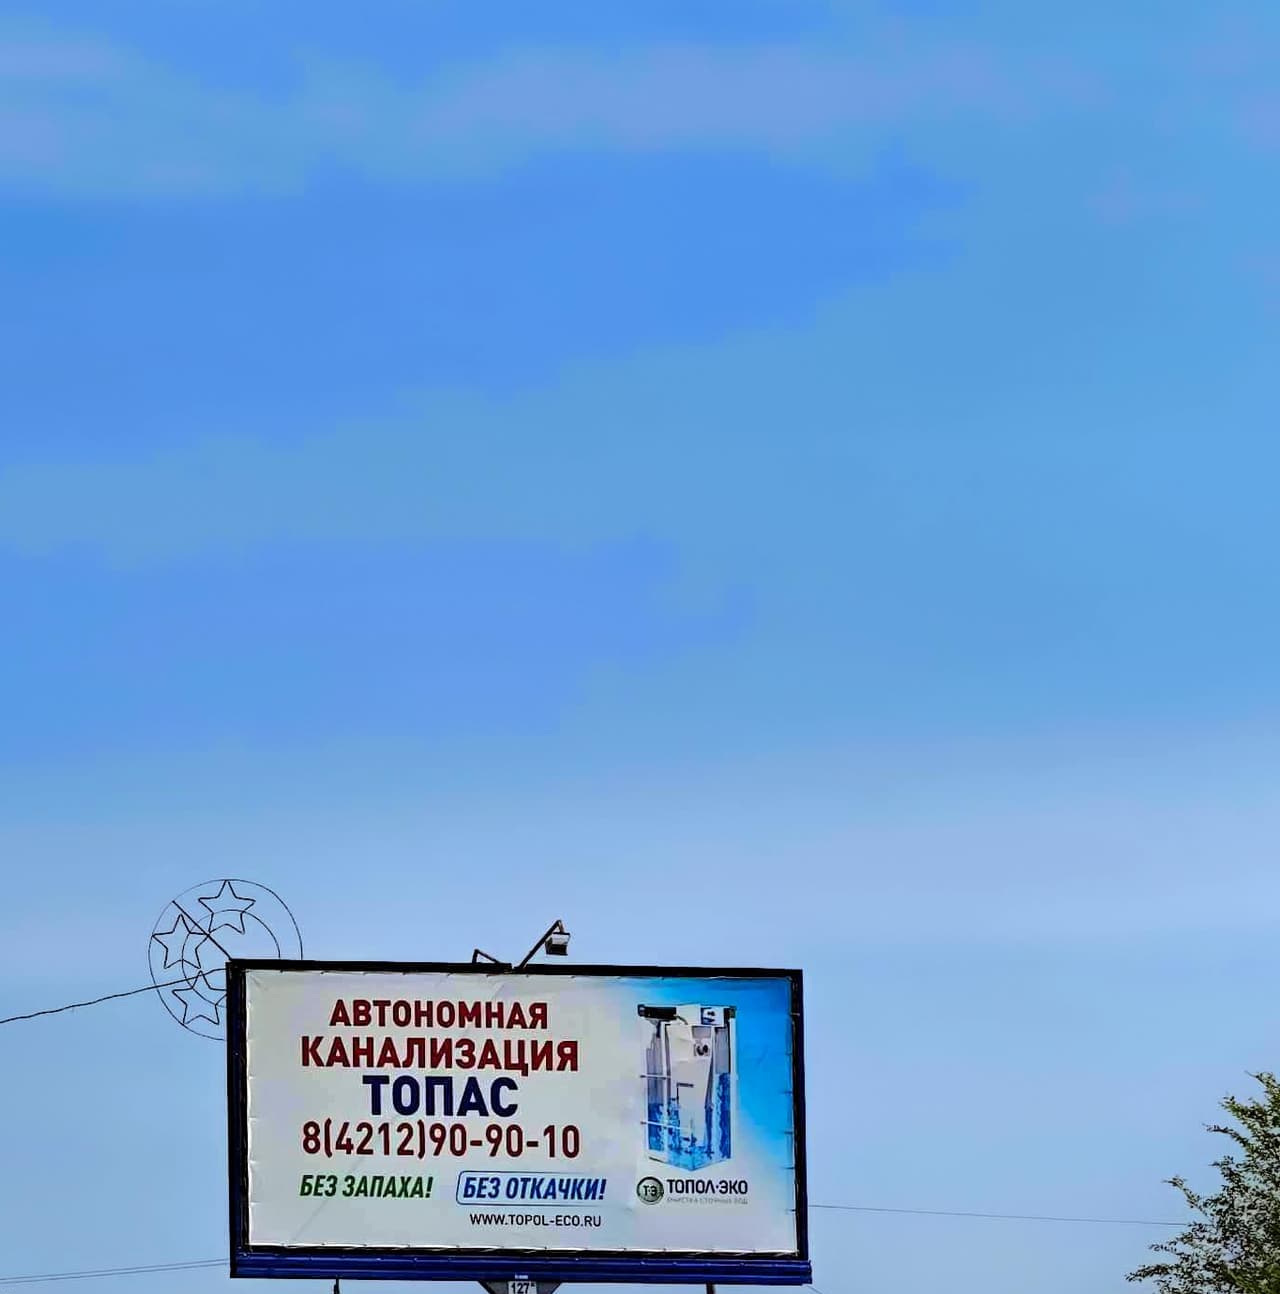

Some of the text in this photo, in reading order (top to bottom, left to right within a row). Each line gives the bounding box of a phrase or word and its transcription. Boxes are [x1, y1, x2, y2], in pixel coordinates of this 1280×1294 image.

[329, 999, 548, 1029] АВТОНОМНАЯ
[301, 1036, 579, 1077] КАНАЛИЗАЦИЯ
[362, 1075, 519, 1117] ТОПАС
[302, 1119, 581, 1159] 8(4212)90-90-10
[299, 1174, 434, 1199] БЕЗ ЗАПАХА!
[463, 1177, 607, 1201] БЕЗ ОТКАЧКИ!
[469, 1213, 602, 1228] WWW.TOPOL-ECO.RU
